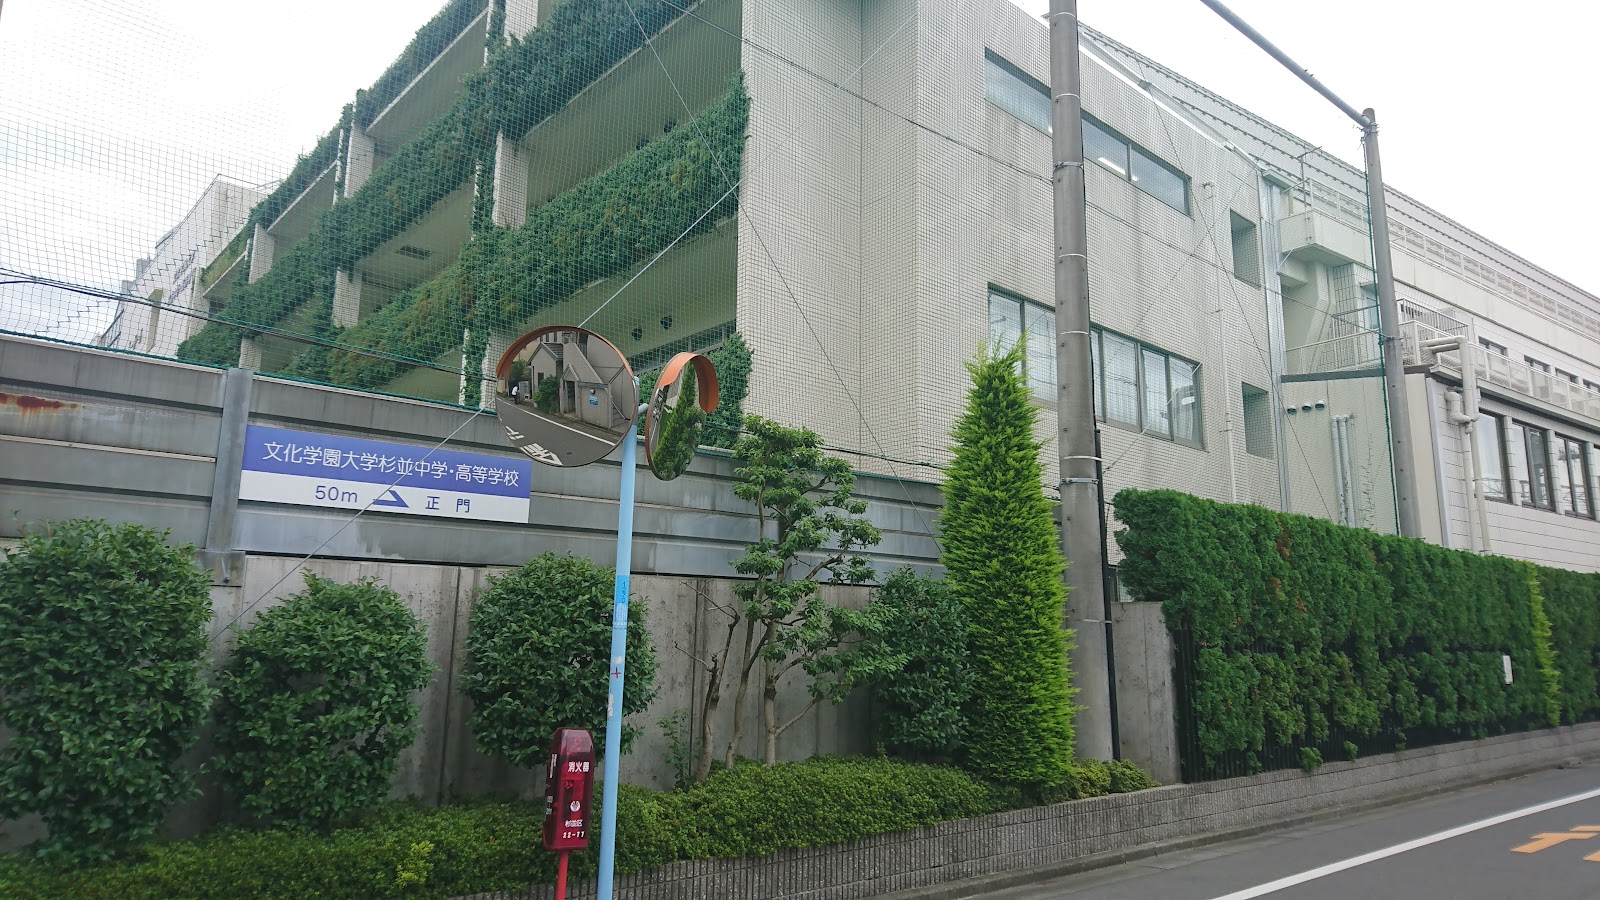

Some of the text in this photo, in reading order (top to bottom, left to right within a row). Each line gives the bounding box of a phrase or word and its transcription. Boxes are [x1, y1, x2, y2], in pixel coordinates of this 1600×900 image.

[314, 485, 358, 503] 50m
[567, 761, 590, 773] 消火器
